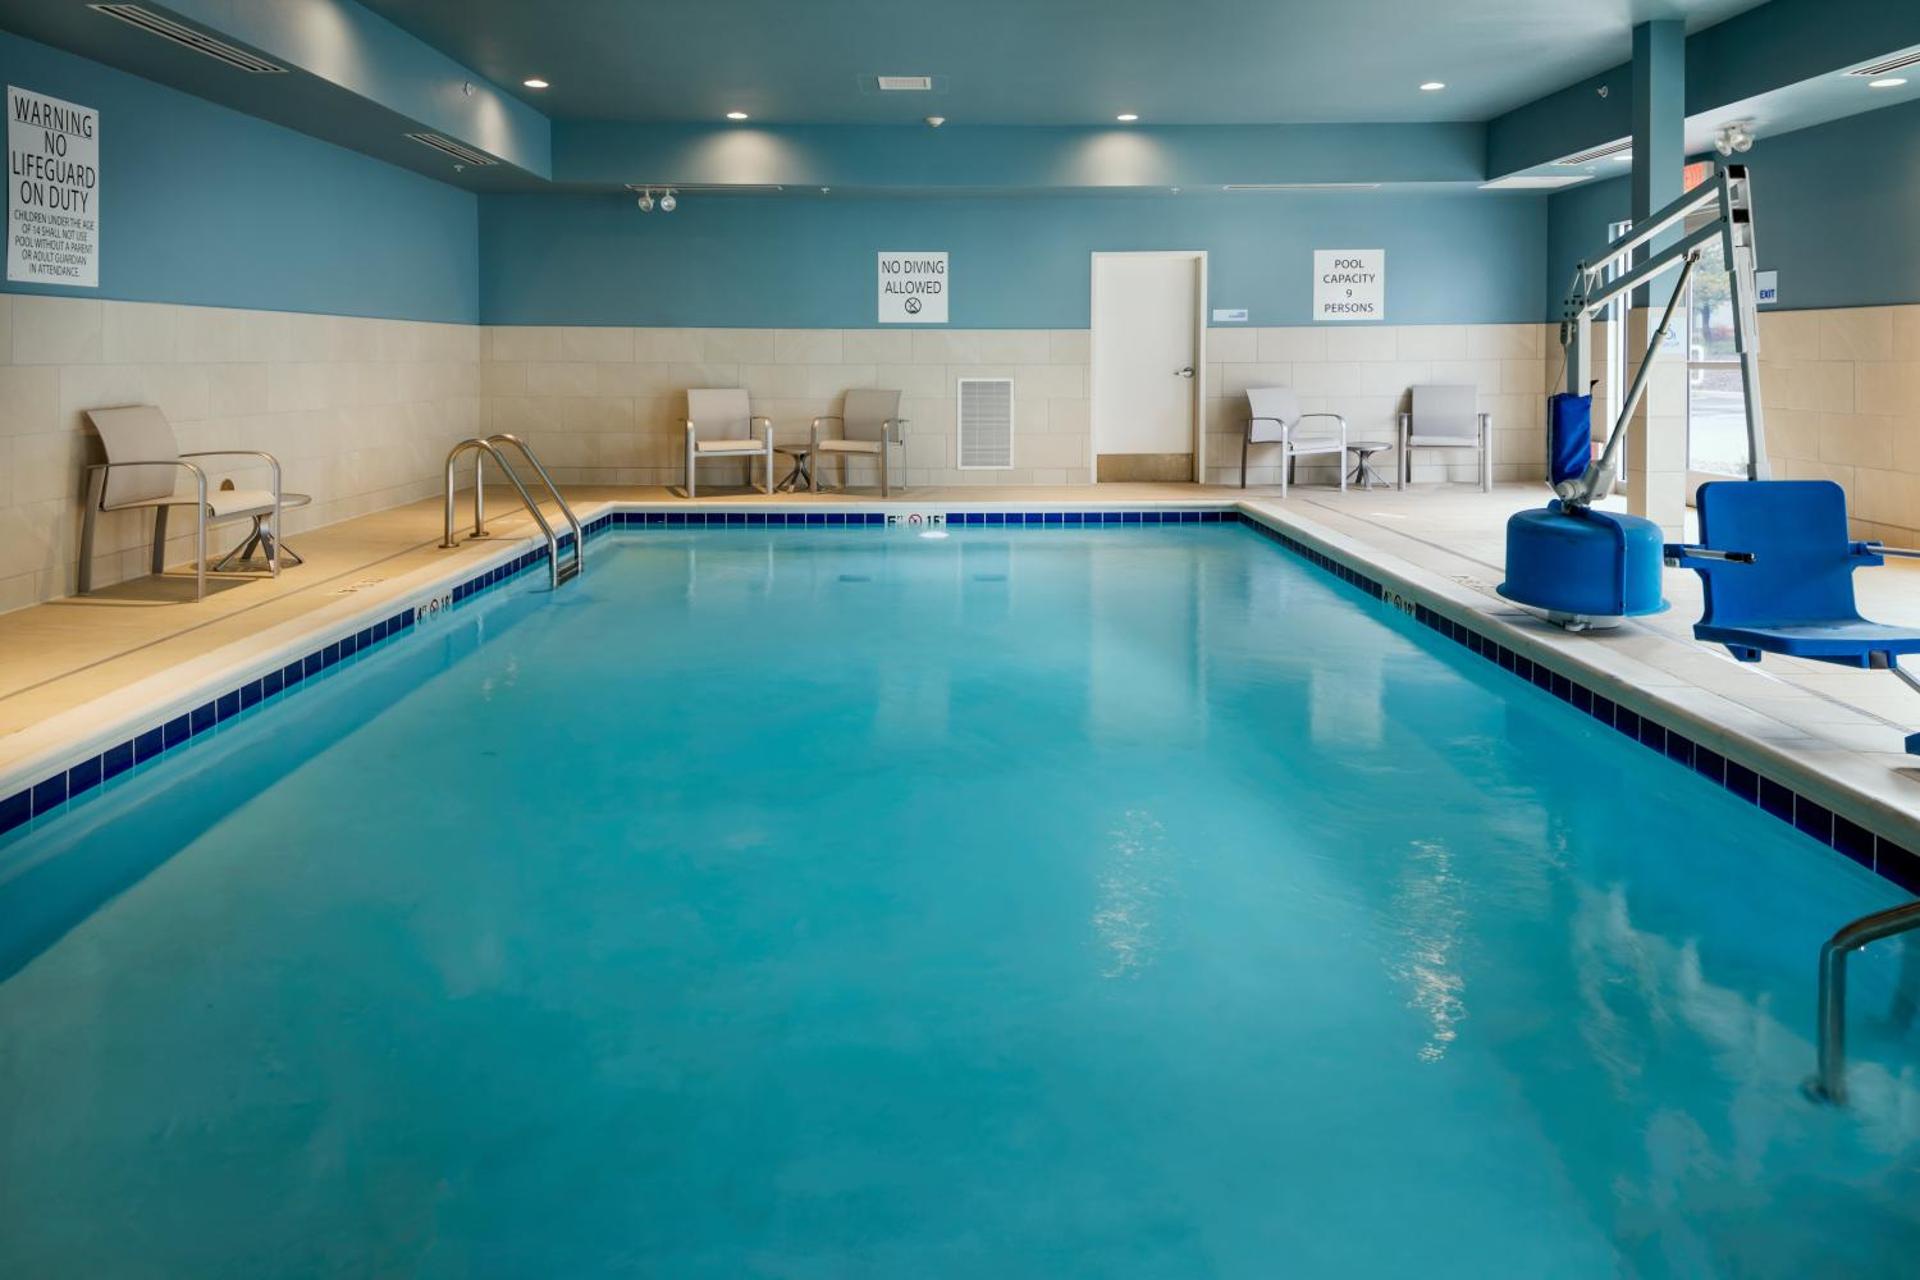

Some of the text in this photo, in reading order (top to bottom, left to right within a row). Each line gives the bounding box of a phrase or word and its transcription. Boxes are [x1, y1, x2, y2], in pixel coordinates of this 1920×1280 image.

[14, 95, 92, 138] WARNING
[44, 130, 67, 157] NO
[12, 150, 95, 188] LIFEGUARD
[20, 180, 88, 213] ON DUTY
[14, 209, 94, 230] CHILDREN UNDER THE AGE
[22, 223, 31, 233] OF
[41, 226, 60, 238] SHALL
[62, 229, 75, 240] NOT
[15, 235, 93, 254] POOL WITHOUT A PARENT
[22, 248, 87, 265] OR ADULT GUARDIAN
[1334, 259, 1365, 269] POOL
[29, 263, 80, 277] IN ATTENDANCE
[882, 260, 944, 274] NO DIVING
[1323, 273, 1375, 284] CAPACITY
[885, 280, 942, 294] ALLOWED
[1345, 288, 1353, 298] 9
[1760, 289, 1775, 299] EXIT
[1324, 302, 1374, 313] PERSONS
